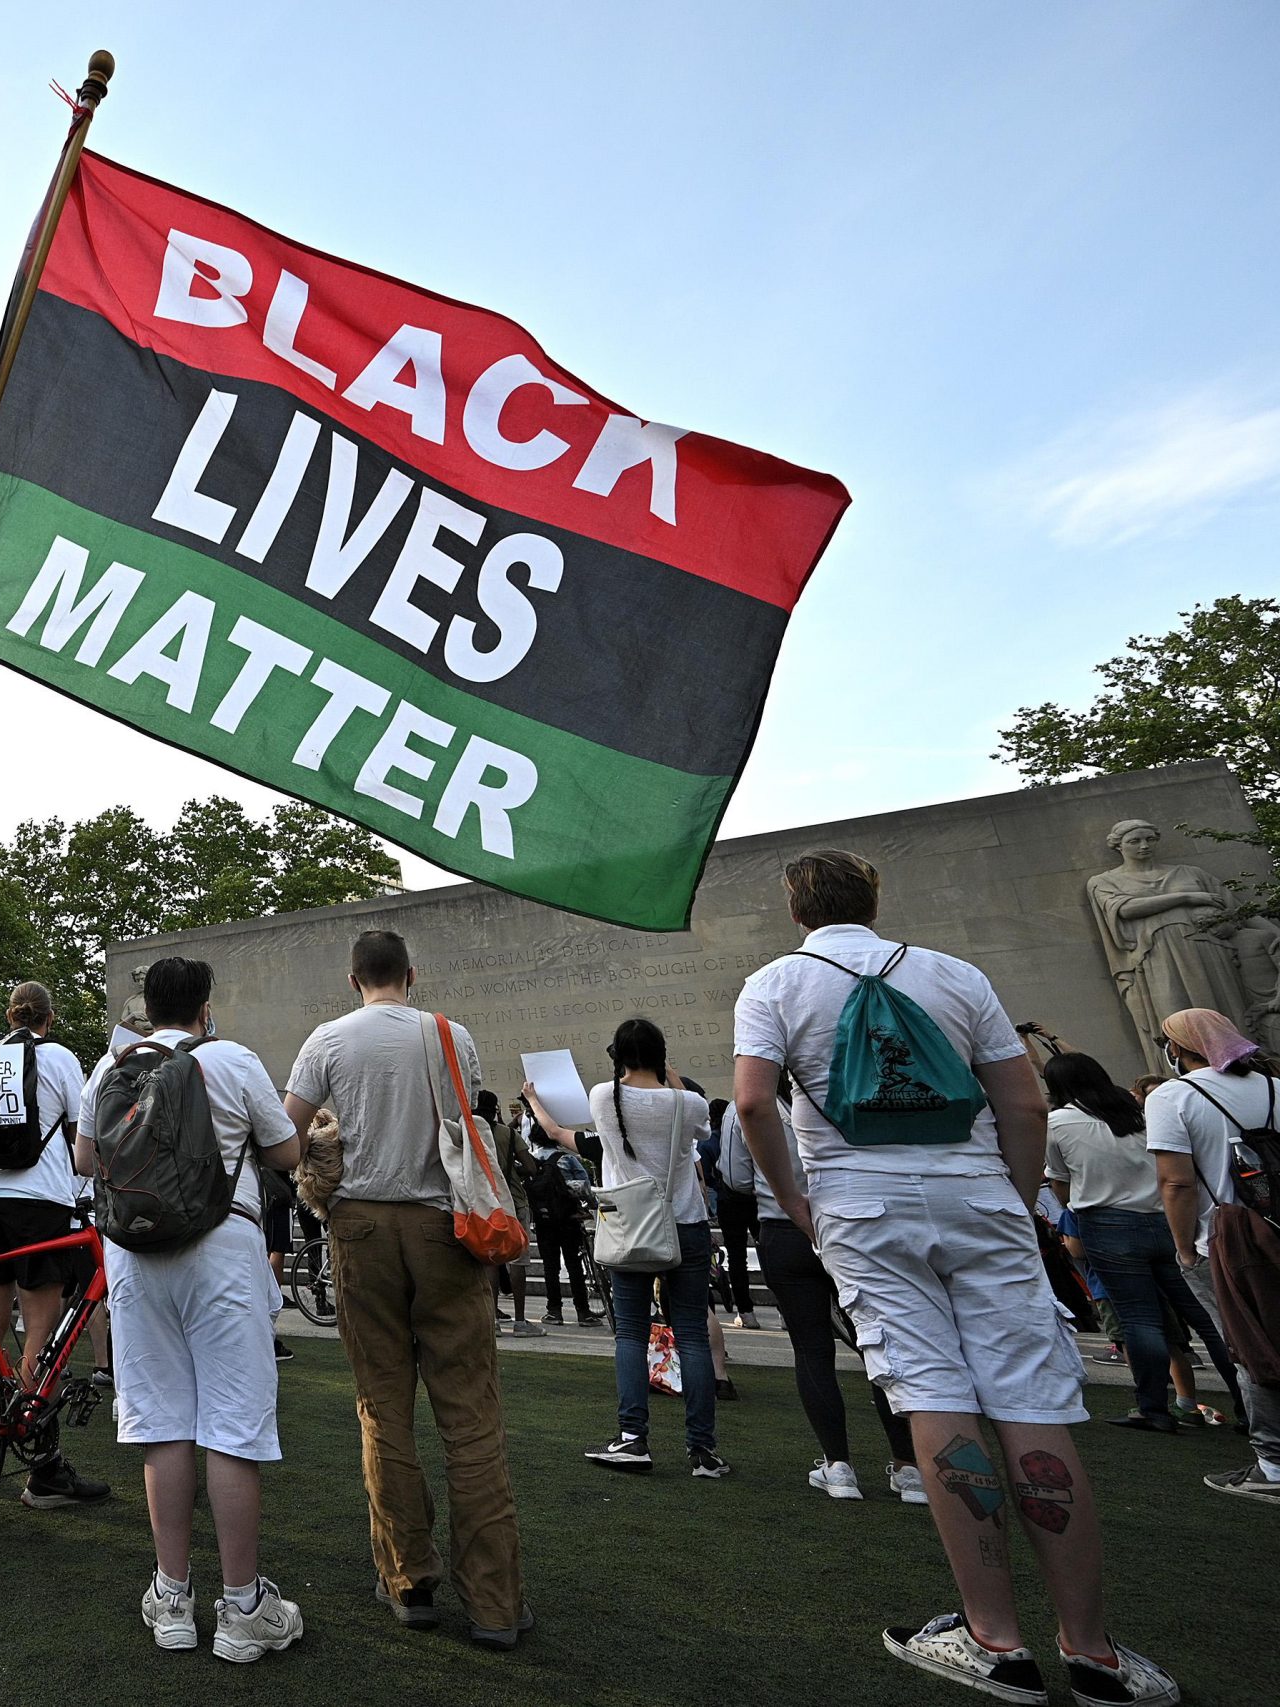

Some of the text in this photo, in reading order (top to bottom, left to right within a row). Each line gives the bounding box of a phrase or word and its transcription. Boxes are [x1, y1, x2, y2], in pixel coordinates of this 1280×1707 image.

[153, 228, 691, 527] BLACK
[151, 387, 564, 684] LIVES
[6, 534, 539, 860] MATTER
[416, 934, 669, 976] HIS MEMORIAL IS DEDICATED
[301, 1003, 319, 1016] TO
[323, 1000, 348, 1013] THE
[408, 989, 439, 1004] MEN
[444, 985, 475, 999] AND
[480, 978, 537, 995] WOMEN
[544, 975, 565, 989] OF
[569, 971, 602, 986] THE
[608, 960, 697, 983] BOROUGH
[703, 957, 728, 971] OF
[495, 1009, 512, 1023] IN
[518, 1006, 547, 1021] THE
[553, 999, 624, 1017] SECOND
[631, 992, 697, 1009] WORLD
[481, 1036, 545, 1053] THOSE
[552, 1031, 601, 1047] WHO
[895, 1091, 927, 1100] HERO
